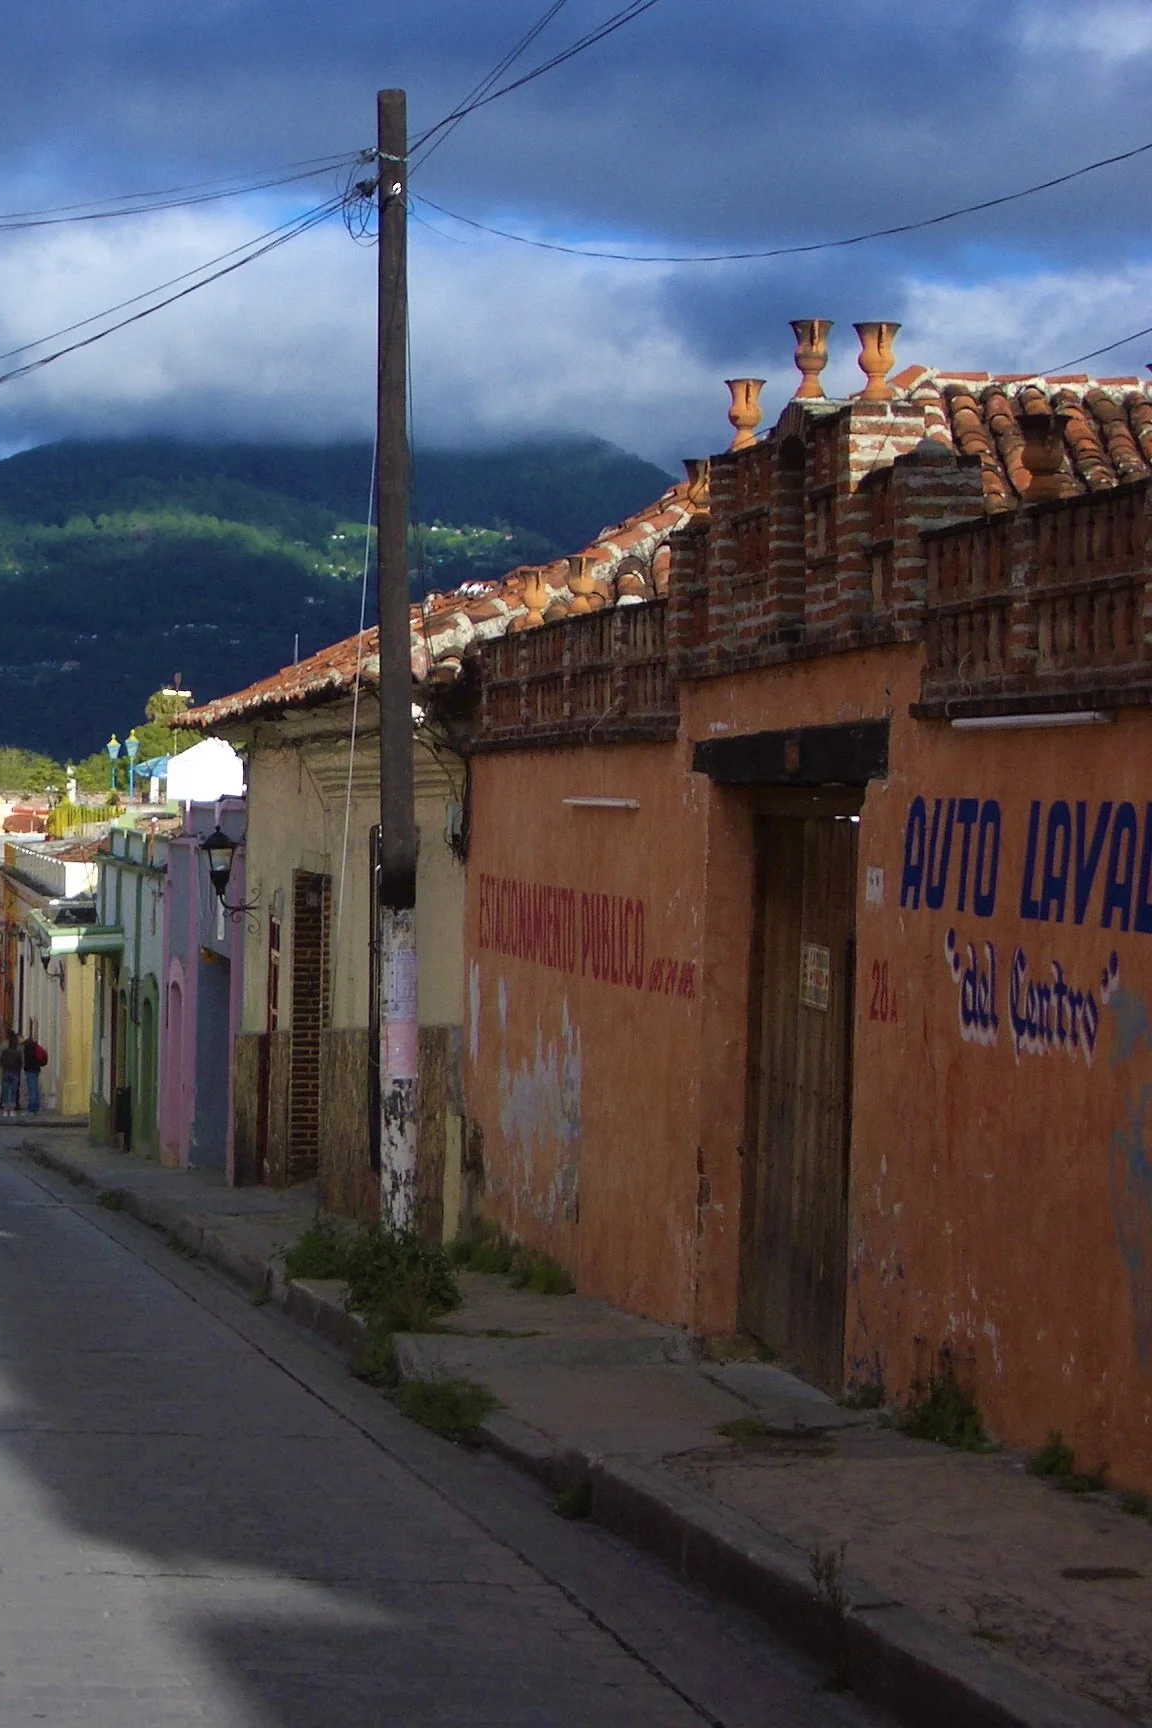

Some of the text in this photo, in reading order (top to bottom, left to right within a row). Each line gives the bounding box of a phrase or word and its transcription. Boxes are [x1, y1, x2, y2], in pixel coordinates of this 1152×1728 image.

[900, 796, 1002, 917] AUTO
[480, 872, 576, 974] ESTACIONAMIENTO
[581, 891, 644, 990] PUBLICO
